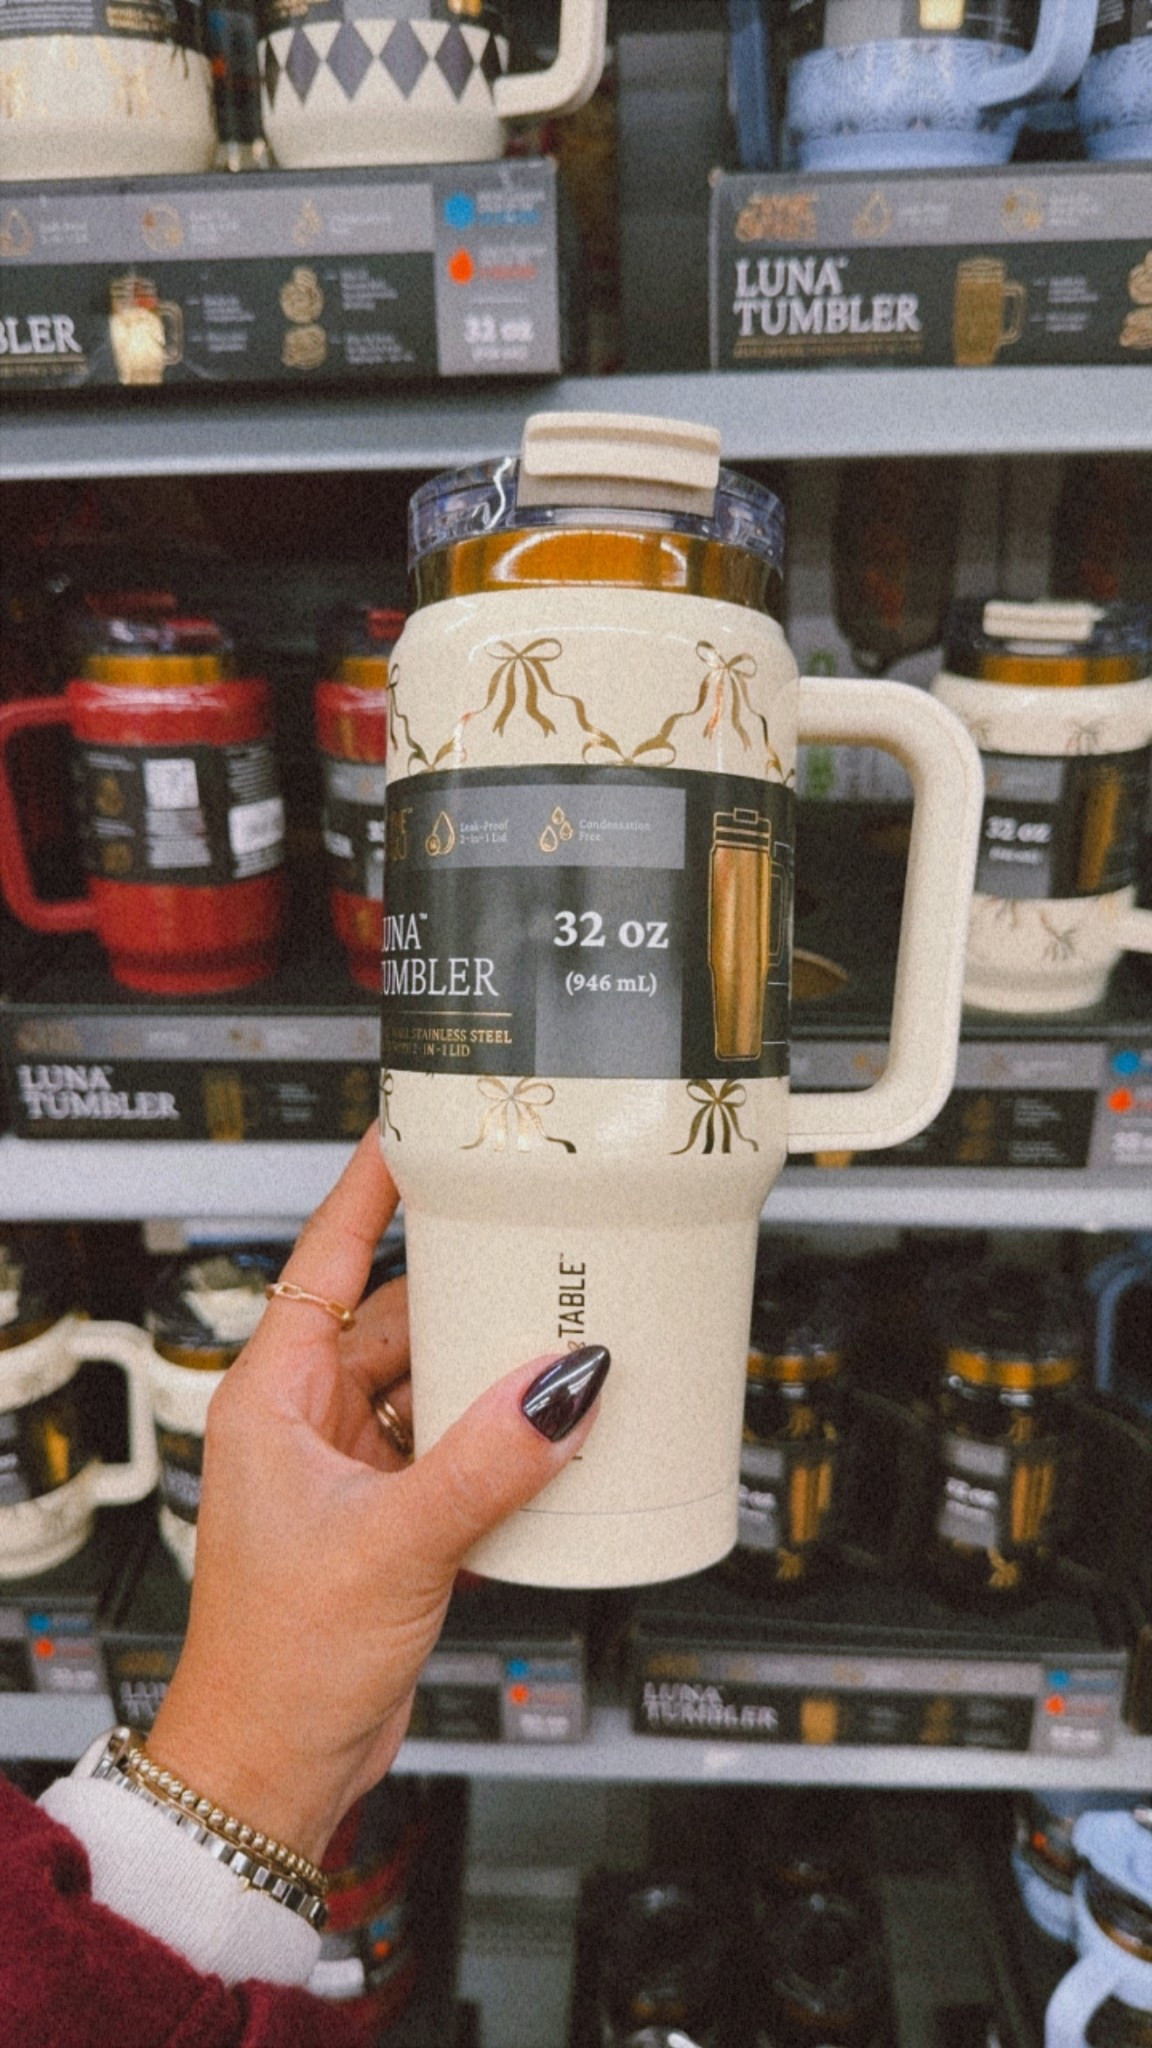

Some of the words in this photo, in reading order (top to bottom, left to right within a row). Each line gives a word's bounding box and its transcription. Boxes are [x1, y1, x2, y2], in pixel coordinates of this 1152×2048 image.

[733, 293, 922, 336] TUMBLER
[579, 819, 652, 831] Condensation
[579, 831, 601, 842] Free
[985, 815, 1017, 841] 32
[553, 910, 606, 948] 32
[618, 920, 669, 949] oz
[381, 957, 500, 997] UMBLER
[565, 970, 612, 996] (946
[615, 971, 658, 998] mL)
[448, 1043, 471, 1058] LID
[470, 1029, 513, 1045] STEEL
[21, 1089, 180, 1120] TUMBLER
